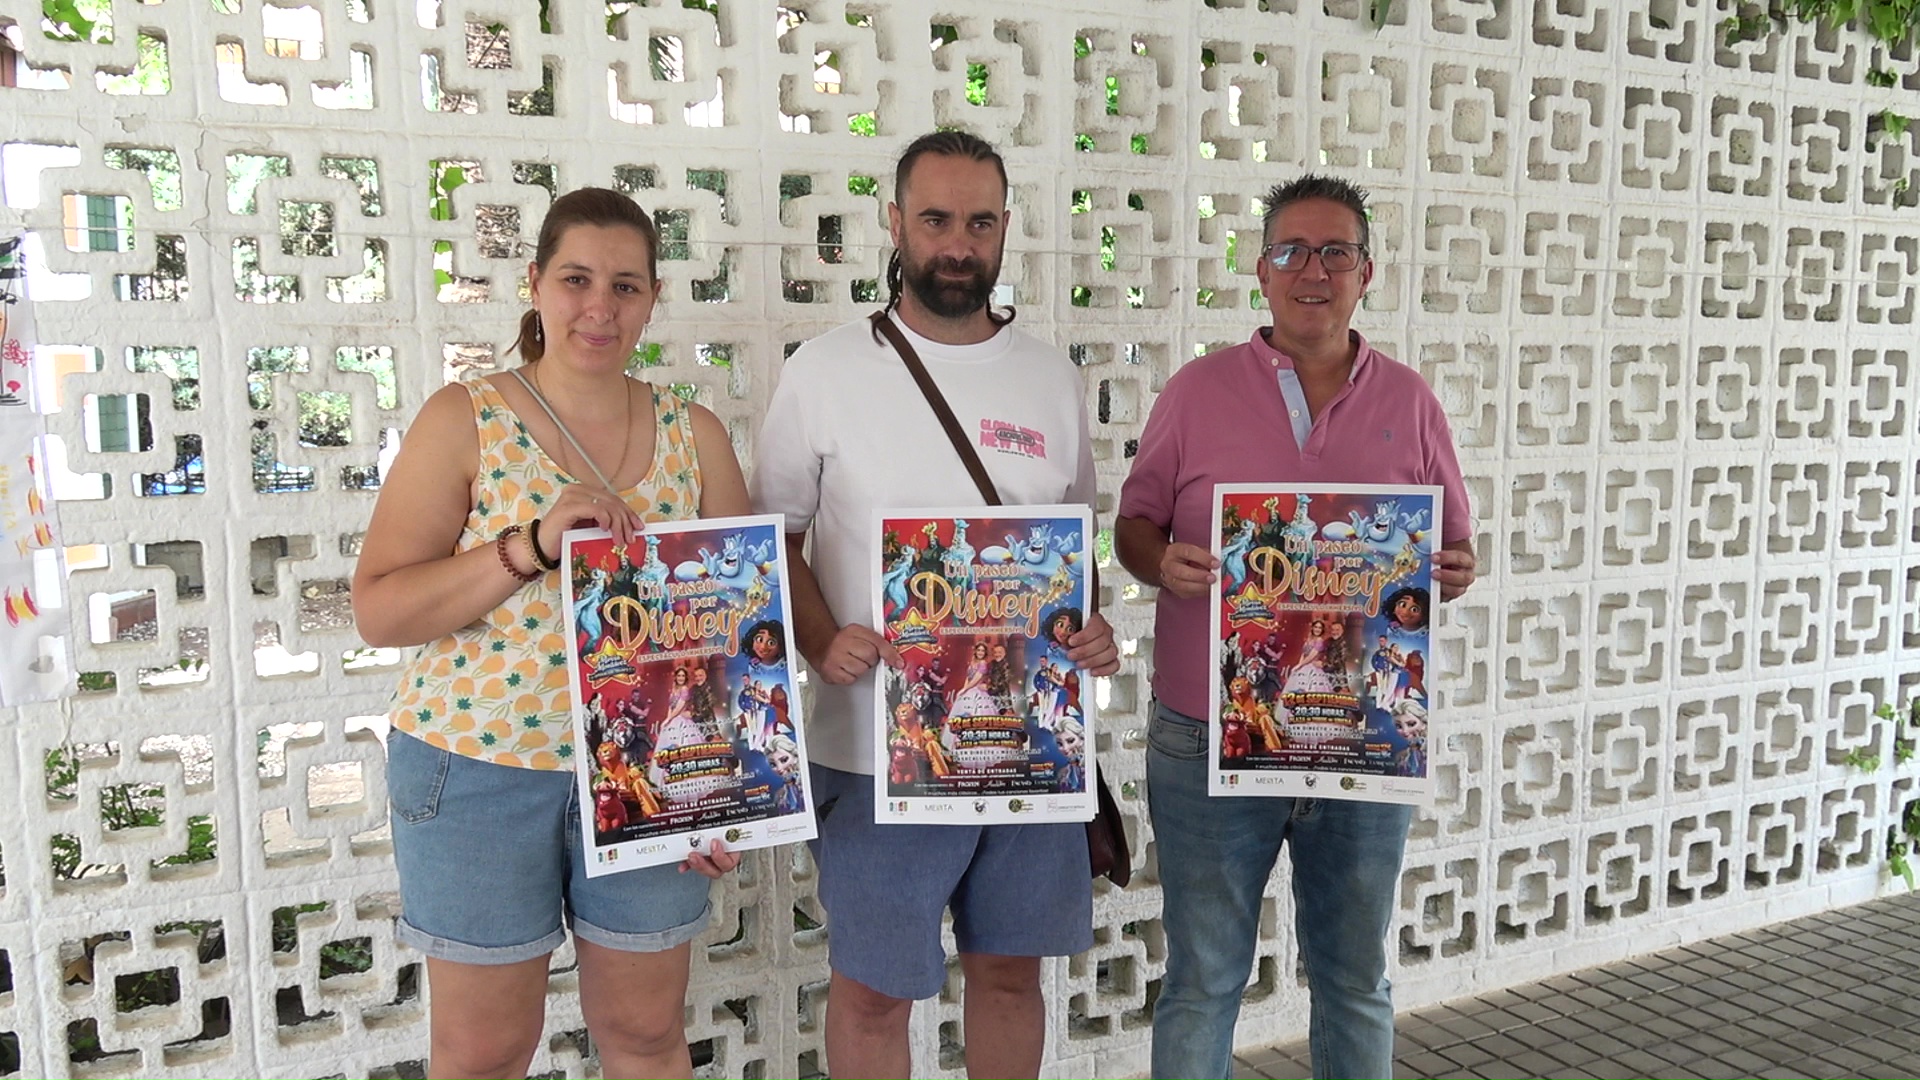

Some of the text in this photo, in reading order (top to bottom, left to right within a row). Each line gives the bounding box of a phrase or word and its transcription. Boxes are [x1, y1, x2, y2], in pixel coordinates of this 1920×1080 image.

[980, 431, 1012, 449] NEW
[1284, 534, 1362, 560] Un paseo
[944, 559, 1019, 584] Un paseo
[1334, 556, 1363, 571] por
[636, 578, 714, 604] Un paseo
[993, 579, 1021, 595] por
[1249, 546, 1382, 618] Disney
[689, 595, 718, 614] por
[910, 571, 1040, 639] Disney
[603, 596, 739, 658] Disney
[1281, 693, 1295, 706] 12
[1306, 693, 1358, 706] SEPTIEMBRE
[1322, 708, 1345, 717] HORAS
[947, 716, 961, 730] 12
[972, 716, 1023, 728] SEPTIEMBRE
[988, 731, 1011, 740] HORAS
[655, 749, 668, 764] 12
[679, 743, 732, 758] SEPTIEMBRE
[697, 758, 721, 769] HORAS
[668, 803, 689, 811] VENTA
[699, 796, 731, 806] ENTRADAS
